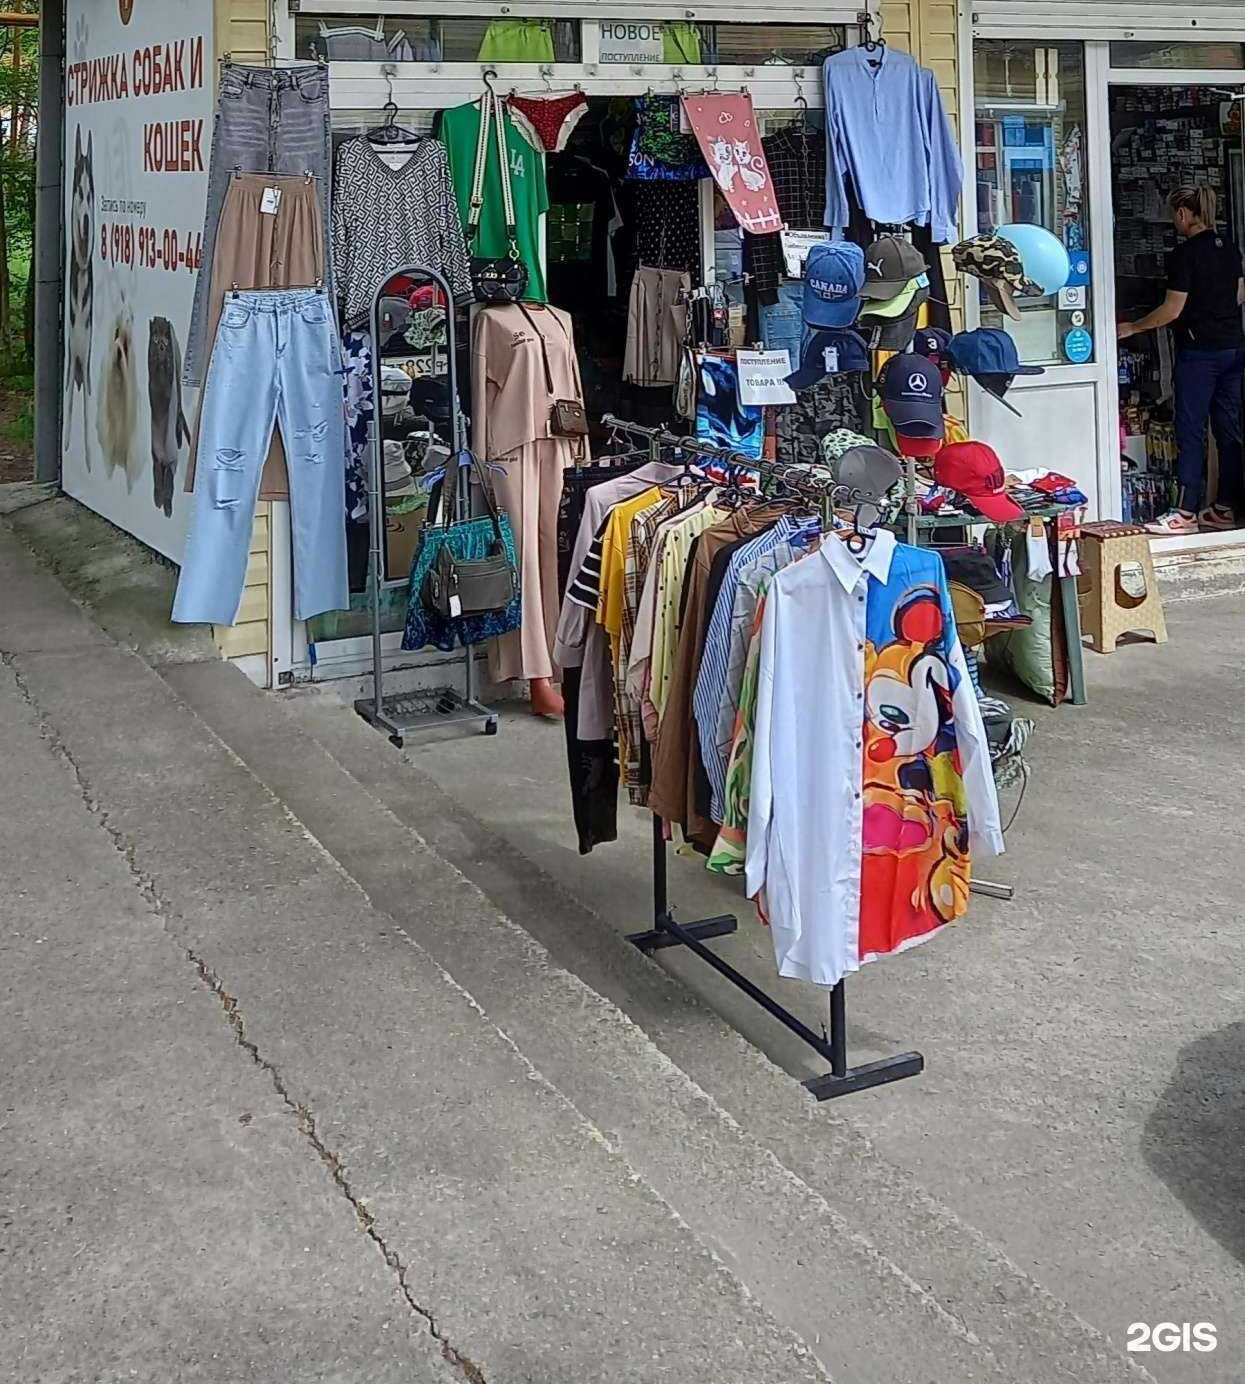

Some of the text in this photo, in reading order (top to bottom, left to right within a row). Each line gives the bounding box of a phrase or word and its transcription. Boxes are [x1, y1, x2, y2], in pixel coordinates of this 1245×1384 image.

[601, 23, 663, 41] НОВОЕ
[601, 52, 661, 62] ПОСТУПЛЕНИЕ
[67, 35, 202, 106] СТРИЖКА СОБАК И
[144, 119, 204, 172] КОШЕК
[510, 148, 525, 178] LA
[101, 223, 107, 261] 8
[111, 222, 134, 271] (918)
[809, 278, 848, 294] CANADA
[927, 337, 938, 350] 3
[745, 378, 775, 387] ТОВАРА
